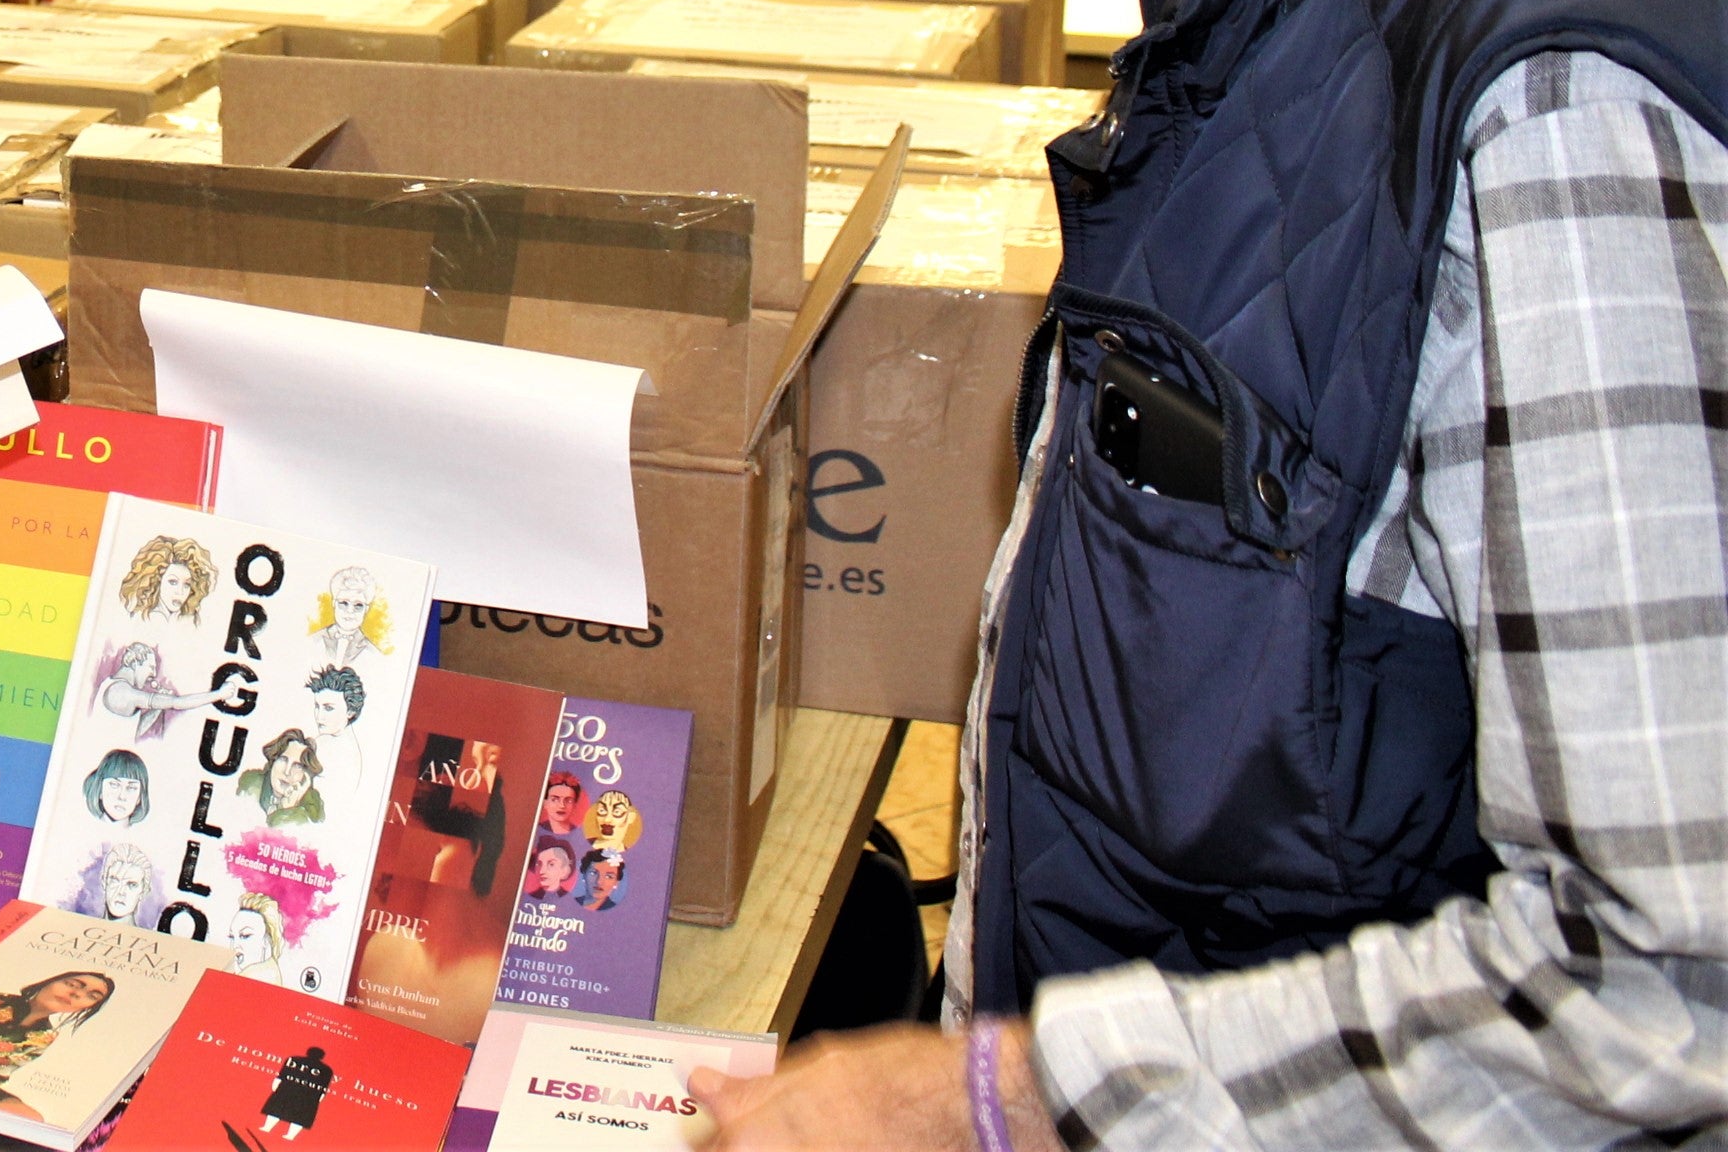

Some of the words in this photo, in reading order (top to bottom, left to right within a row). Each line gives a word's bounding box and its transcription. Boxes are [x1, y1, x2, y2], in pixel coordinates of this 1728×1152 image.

[11, 516, 52, 535] POR
[66, 526, 90, 540] LA
[158, 544, 285, 942] ORGULLO
[418, 759, 482, 791] AÑO
[256, 842, 271, 858] 50
[227, 851, 235, 863] 5
[235, 853, 268, 872] décadas
[268, 863, 280, 876] de
[280, 866, 304, 883] lucha
[303, 872, 332, 889] LGTBI+
[40, 931, 179, 974] CATTANA
[83, 927, 159, 955] GATA
[509, 931, 568, 953] mundo
[513, 957, 574, 976] TRIBUTO
[358, 977, 391, 996] Cyrus
[391, 984, 441, 1008] Dunham
[519, 989, 570, 1009] JONES
[294, 1016, 318, 1028] Lola
[322, 1025, 360, 1041] Robles
[569, 1044, 603, 1055] MARTA
[585, 1056, 610, 1065] KIKA
[611, 1059, 652, 1069] FUMERO
[196, 1031, 227, 1048] De
[237, 1043, 322, 1077] nombre
[331, 1073, 343, 1084] y
[354, 1079, 420, 1111] hueso
[231, 1055, 281, 1077] Relatos
[285, 1074, 338, 1097] oscuros
[343, 1093, 378, 1110] trans
[527, 1077, 698, 1116] LESBIANAS
[554, 1111, 583, 1123] ASÍ
[586, 1115, 649, 1131] SOMOS
